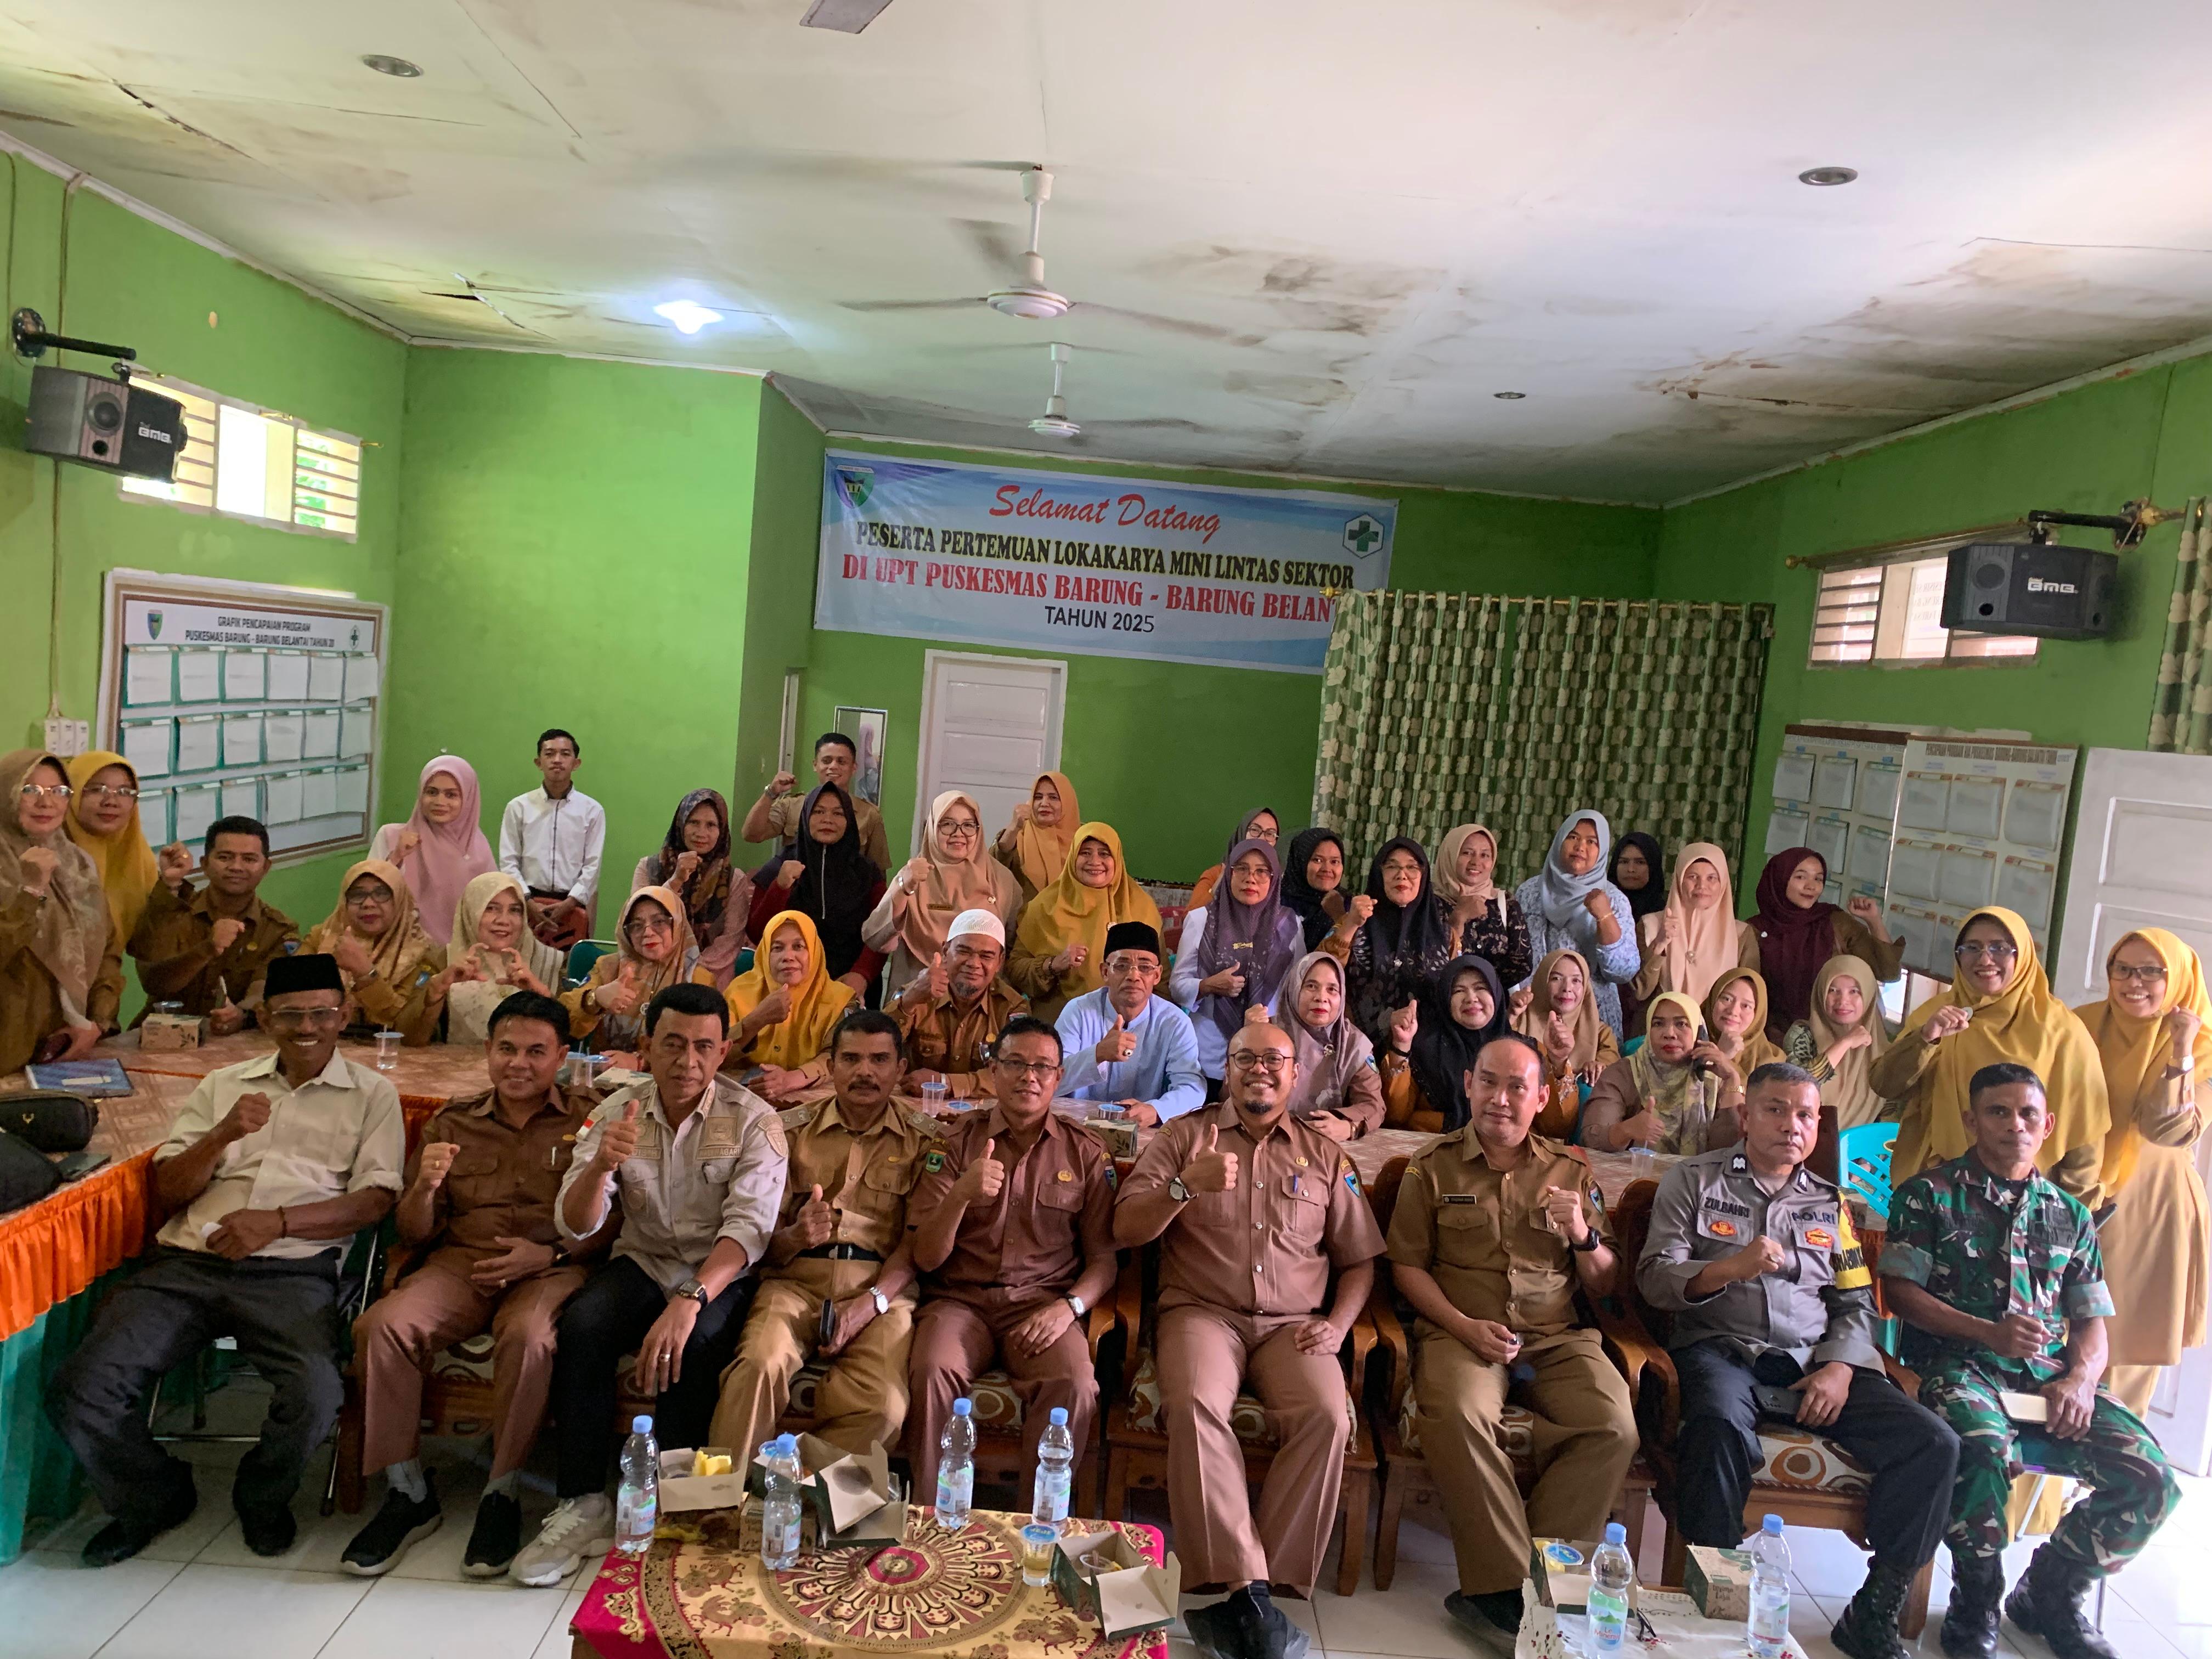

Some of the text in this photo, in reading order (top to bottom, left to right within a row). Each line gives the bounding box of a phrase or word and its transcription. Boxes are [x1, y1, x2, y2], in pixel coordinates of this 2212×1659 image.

[989, 485, 1221, 544] Selamat Datang
[856, 522, 1355, 589] PESERTA PERTEMUAN LOKAKARYA MINI LINTAS SEKTOR
[842, 554, 868, 580] DI
[875, 557, 918, 585] UPT
[925, 561, 1047, 598] PUSKESMAS
[1054, 574, 1143, 607] BARUNG
[1165, 584, 1255, 617] BARUNG
[1261, 593, 1336, 623] BELAN
[218, 616, 241, 628] GRAFIK
[282, 621, 311, 632] PROGRAM
[1045, 605, 1155, 633] TAHUN 2025
[185, 630, 224, 642] PUSKESMAS
[225, 632, 251, 644] BARUNG
[256, 634, 280, 645] BARUNG
[1704, 1197, 1836, 1225] ZULBAHRI POLRI
